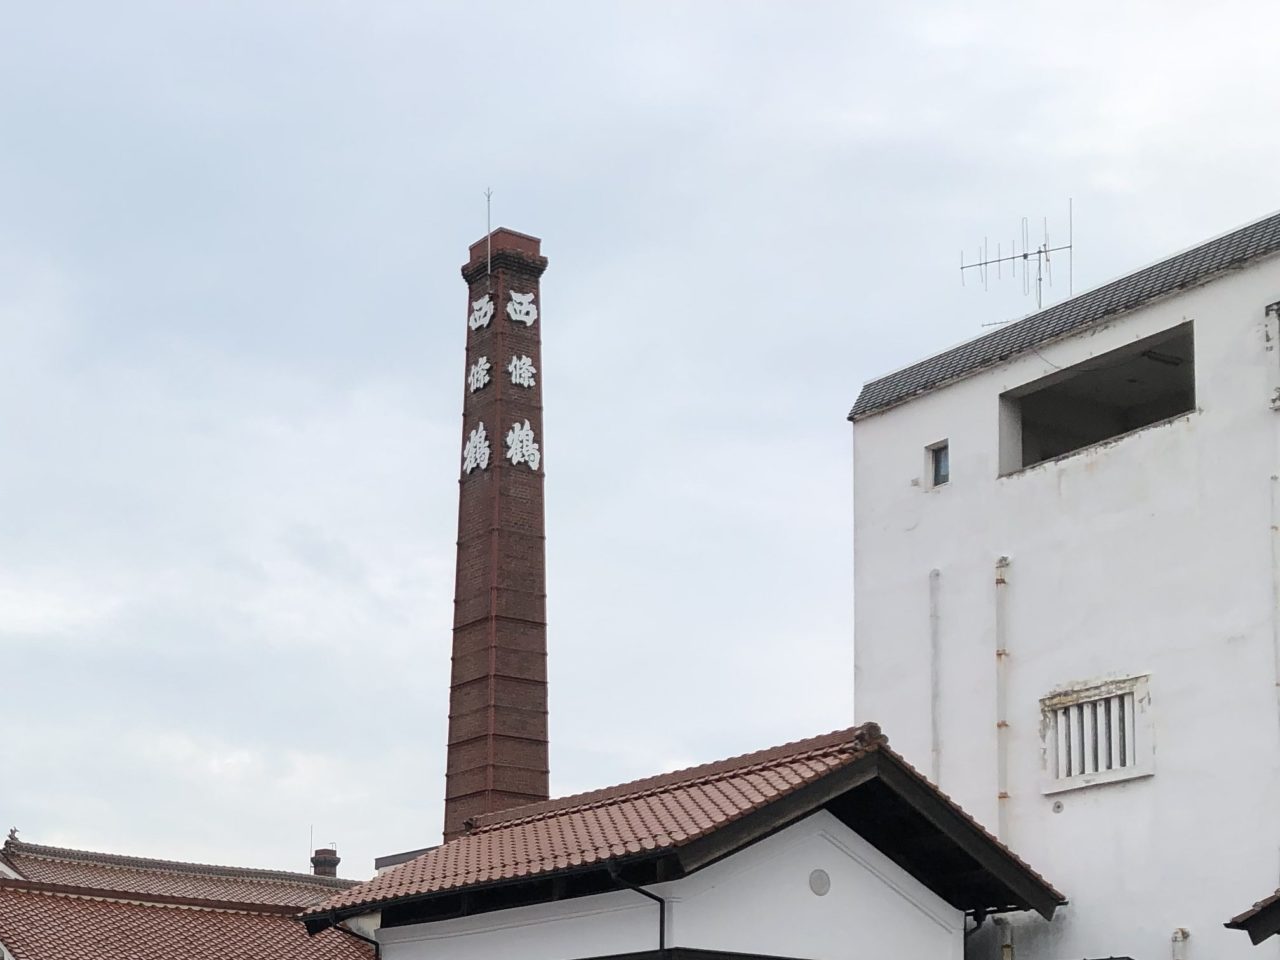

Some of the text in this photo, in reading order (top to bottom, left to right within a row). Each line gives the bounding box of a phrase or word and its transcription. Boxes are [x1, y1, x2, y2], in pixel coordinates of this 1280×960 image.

[463, 294, 494, 474] 西條鶴
[506, 290, 541, 470] 西條鶴
